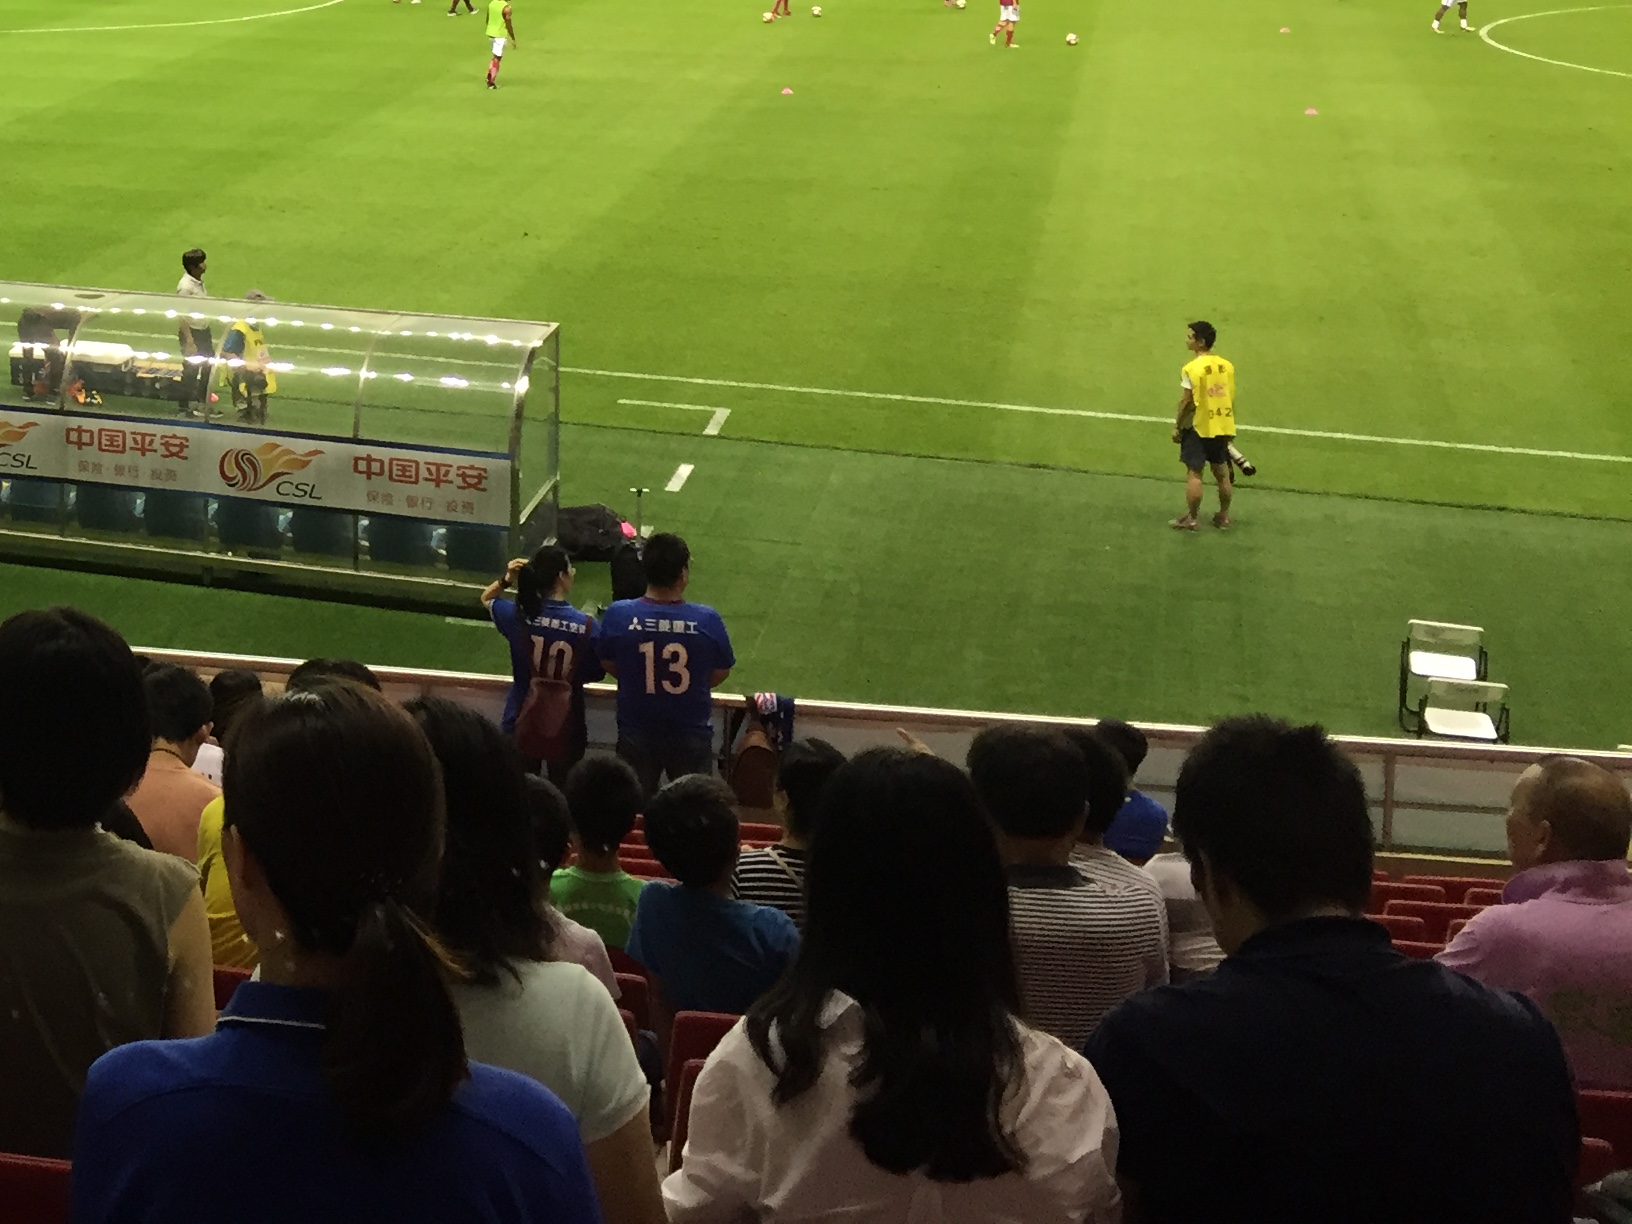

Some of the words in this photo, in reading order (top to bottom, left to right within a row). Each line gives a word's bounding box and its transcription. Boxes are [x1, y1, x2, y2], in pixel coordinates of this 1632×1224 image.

[65, 425, 190, 460] 中国平安
[276, 480, 322, 500] CSL
[352, 454, 488, 492] 中国平安
[531, 635, 573, 680] 10
[638, 641, 691, 695] 13
